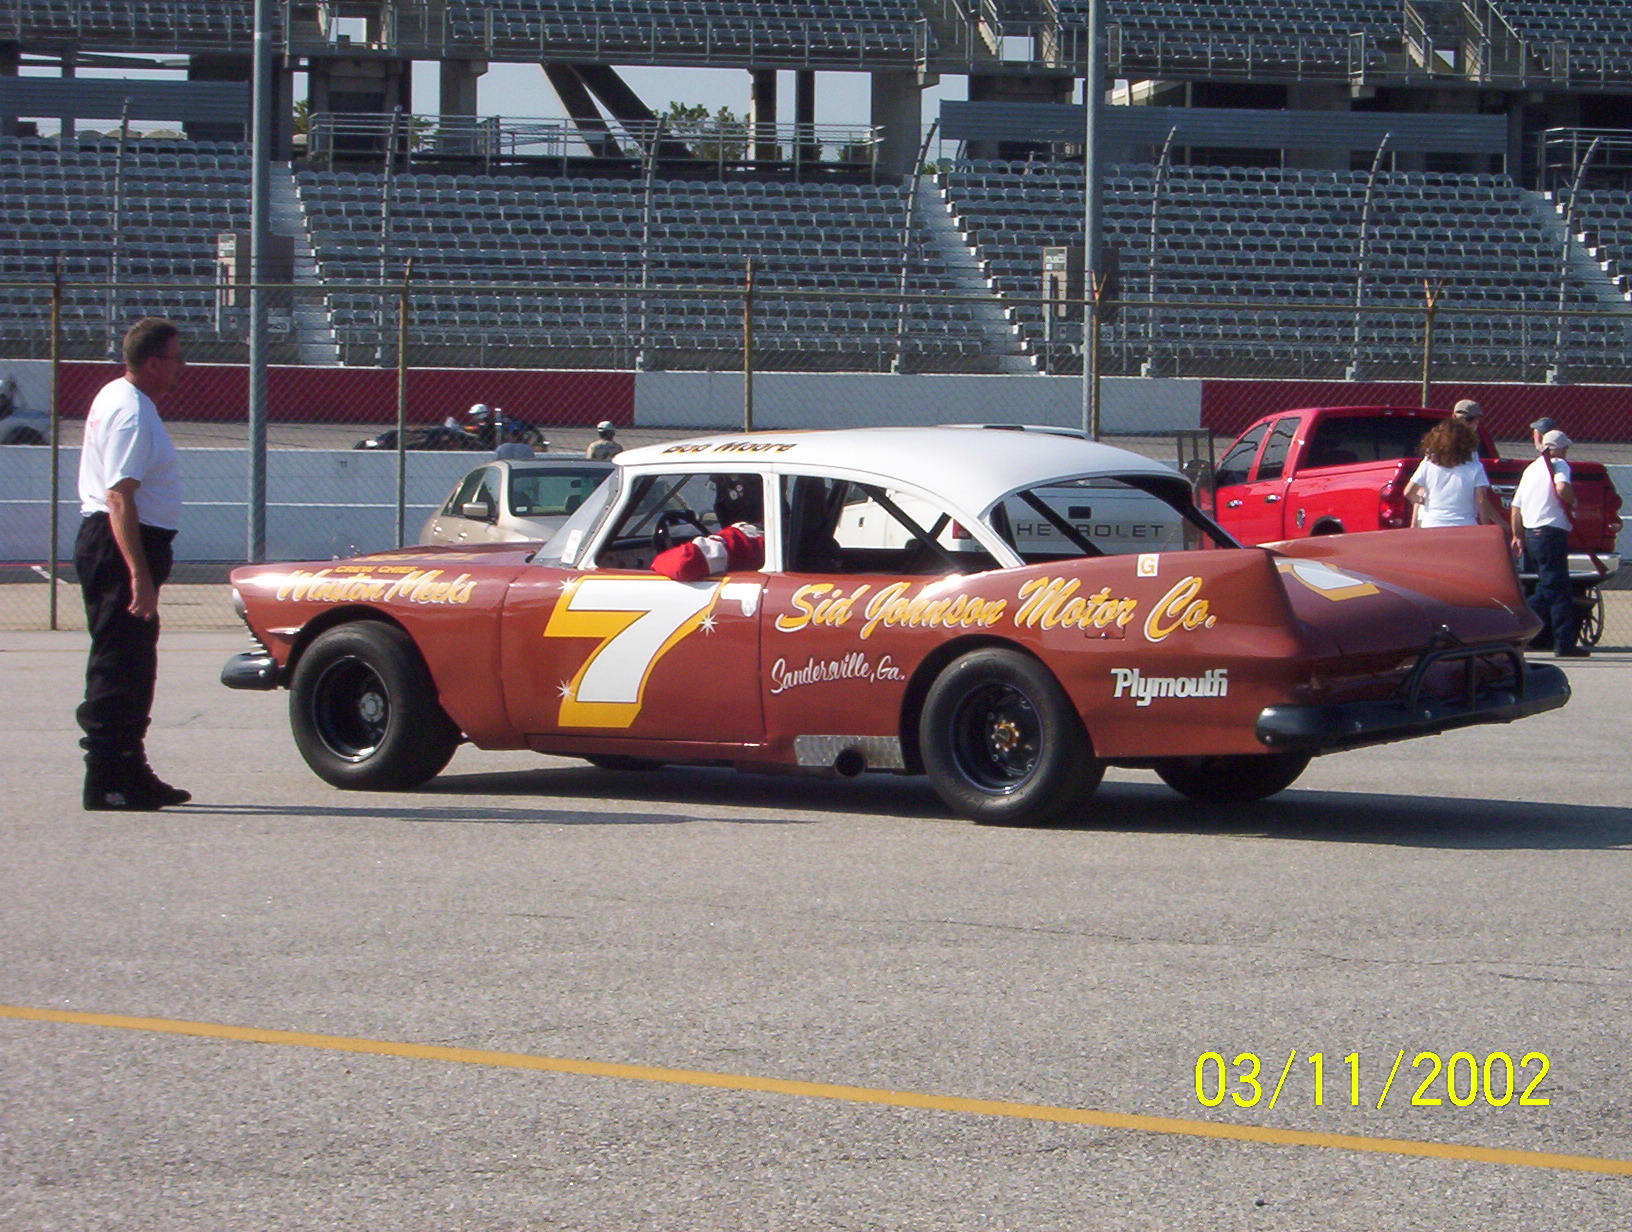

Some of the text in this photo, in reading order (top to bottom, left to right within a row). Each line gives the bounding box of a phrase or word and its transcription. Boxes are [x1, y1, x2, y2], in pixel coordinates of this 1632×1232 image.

[1015, 522, 1164, 538] HEROLET
[1141, 557, 1156, 575] G
[384, 570, 478, 604] Meeks
[775, 575, 1217, 642] Sid Johnson Motor Co.
[543, 574, 732, 728] 7
[1110, 667, 1229, 707] Plymouth
